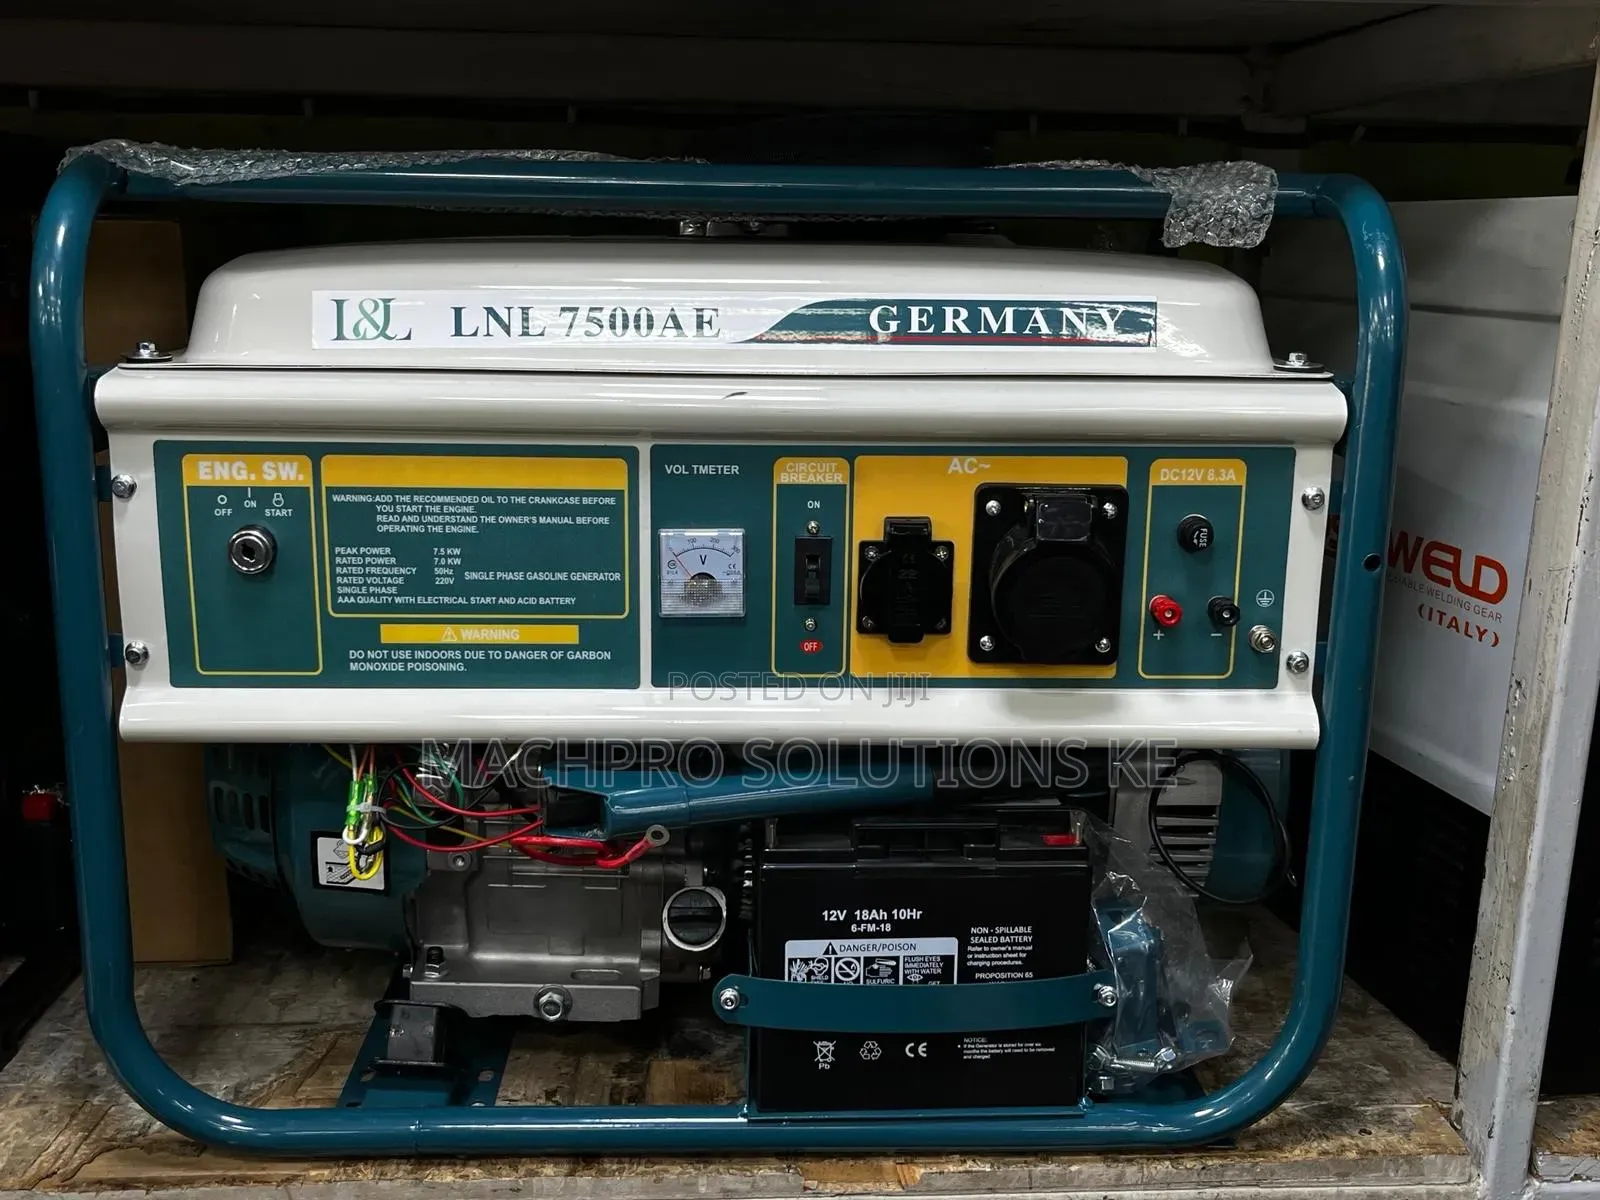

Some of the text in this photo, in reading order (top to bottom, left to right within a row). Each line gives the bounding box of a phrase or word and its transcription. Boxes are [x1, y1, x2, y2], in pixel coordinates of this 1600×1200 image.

[450, 306, 546, 338] LNL
[559, 306, 721, 338] 7500AE
[868, 305, 1126, 336] GERMANY
[198, 461, 304, 481] ENG. SW.
[786, 463, 838, 473] CIRCUIT
[780, 473, 843, 483] BREAKER
[1160, 468, 1205, 481] DC12V
[394, 494, 411, 502] THE
[412, 495, 479, 503] RECOMMENDED
[480, 495, 495, 503] OIL
[528, 496, 580, 504] CRANKCASE
[582, 496, 616, 504] BEFORE
[244, 500, 257, 508] ON
[375, 504, 394, 512] YOU
[395, 504, 423, 512] START
[807, 500, 821, 509] ON
[214, 508, 232, 517] OFF
[265, 508, 293, 517] START
[376, 514, 400, 522] READ
[421, 515, 478, 523] UNDERSTAND
[479, 515, 496, 523] THE
[498, 515, 537, 523] OWNER'S
[539, 516, 574, 524] MANUAL
[575, 516, 609, 524] BEFORE
[376, 524, 425, 532] OPERATING
[1199, 528, 1208, 548] FUSE
[433, 547, 445, 555] 7.5
[335, 556, 363, 564] RATED
[699, 554, 707, 565] V
[335, 566, 416, 574] RATED FREQUENCY
[1388, 530, 1508, 605] WELD
[365, 576, 404, 584] VOLTAGE
[464, 571, 620, 580] SINGLE PHASE GASOLINE GENERATOR
[435, 577, 455, 585] 220V
[356, 595, 392, 603] QUALITY
[416, 596, 468, 604] ELECTRICAL
[470, 596, 496, 604] START
[497, 596, 516, 604] AND
[1427, 585, 1471, 612] WELDING
[1473, 603, 1503, 624] GEAR
[461, 628, 520, 641] WARNING
[803, 642, 818, 651] OFF
[349, 650, 365, 659] DO
[367, 650, 389, 658] NOT
[391, 650, 412, 659] USE
[414, 650, 461, 659] INDOORS
[464, 650, 485, 659] DUE
[487, 650, 502, 659] TO
[504, 650, 548, 659] DANGER
[550, 650, 564, 659] OF
[349, 662, 466, 671] MONOXIDE POISONING.
[822, 908, 923, 921] 12V 18Ah 10Hr
[851, 923, 892, 933] 6-FM-18
[970, 936, 998, 944] SEALED
[839, 943, 917, 953] DANGER/POISON
[818, 1062, 830, 1070] Pb
